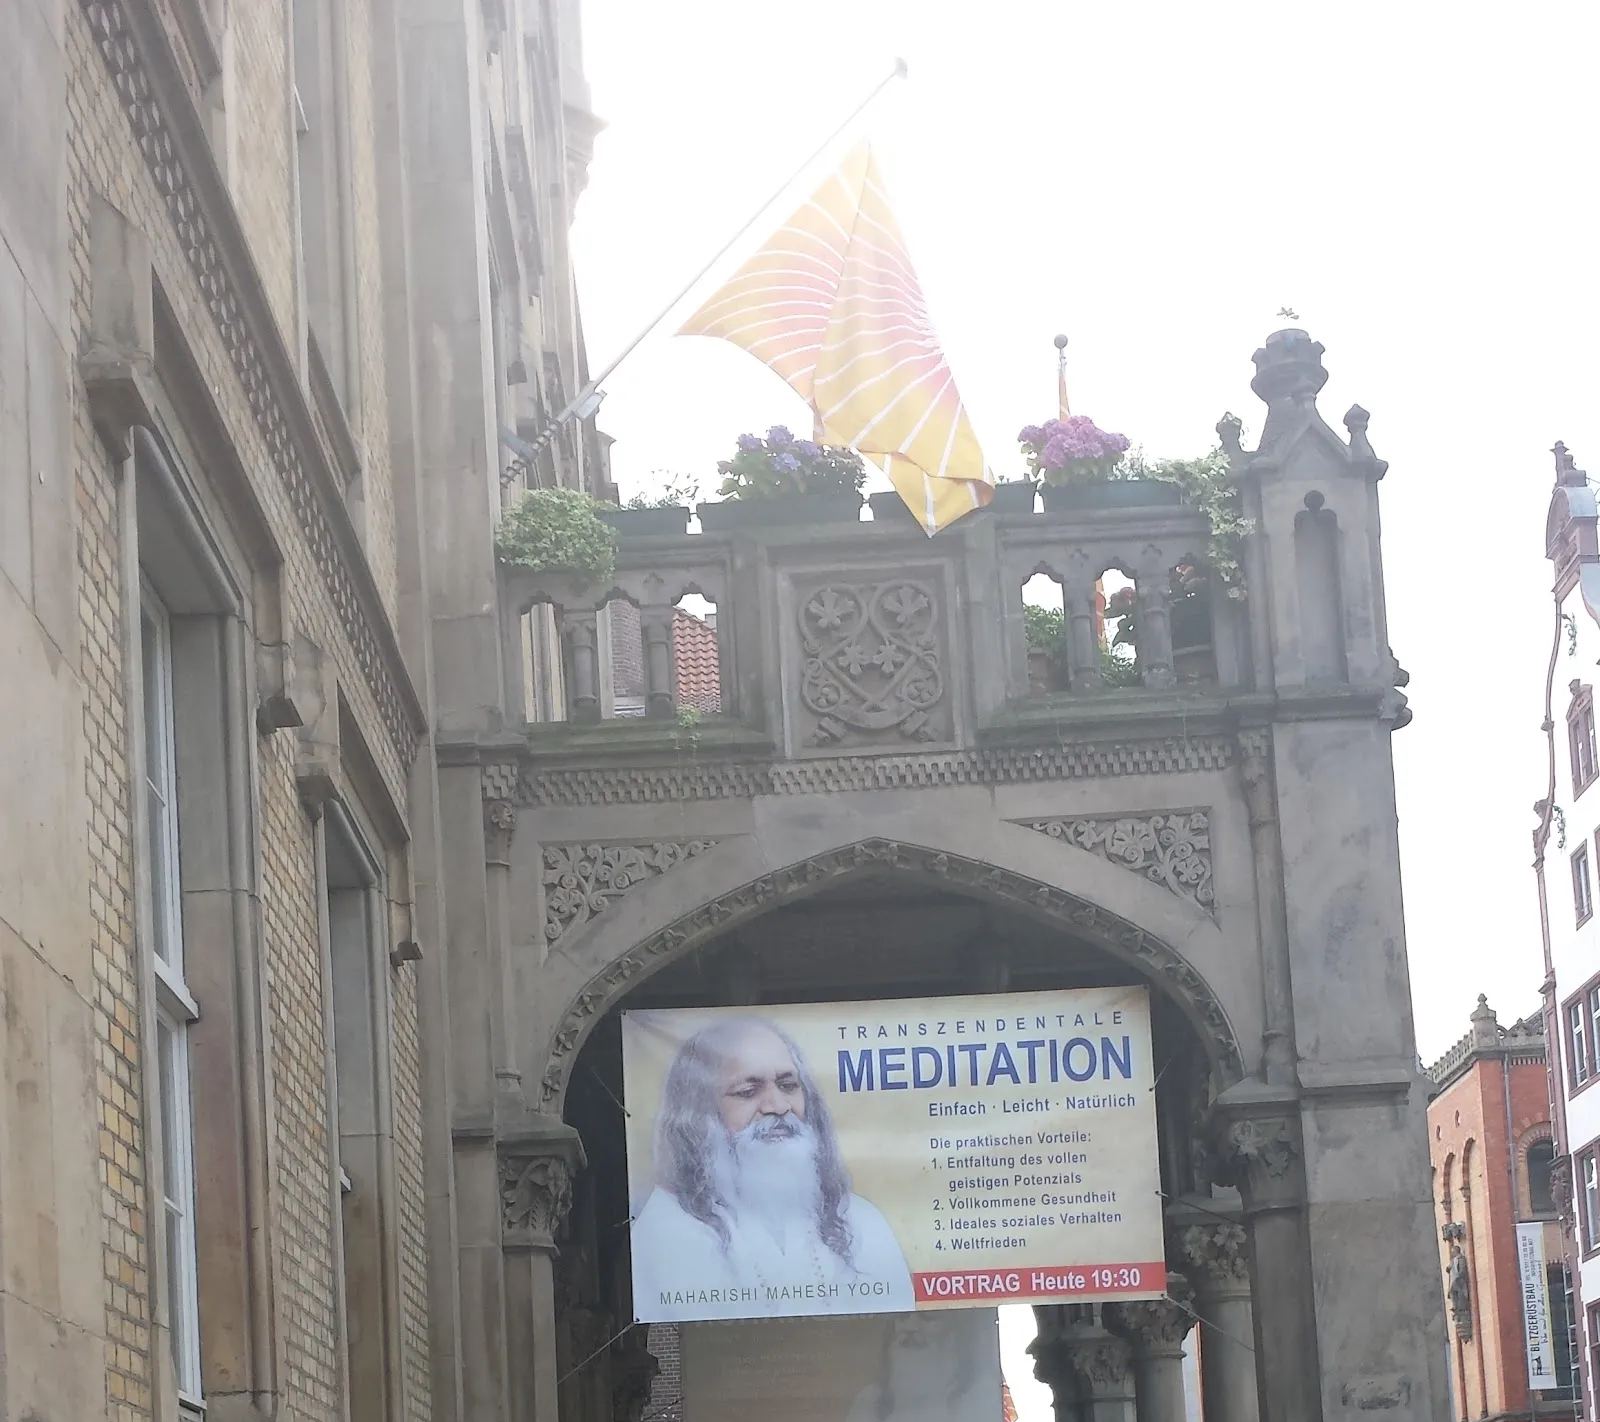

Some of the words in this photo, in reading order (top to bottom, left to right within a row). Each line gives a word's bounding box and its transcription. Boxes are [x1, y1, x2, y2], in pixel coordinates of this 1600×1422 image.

[837, 1010, 1123, 1040] TRANSZENDENTALE
[837, 1035, 1132, 1093] MEDITATION
[929, 1101, 986, 1117] Einfach
[1003, 1098, 1050, 1113] Leicht
[1066, 1093, 1136, 1110] Natürlich
[930, 1138, 951, 1149] Die
[956, 1134, 1033, 1151] praktischen
[1037, 1131, 1092, 1144] Vorteile:
[931, 1157, 943, 1170] 1.
[947, 1154, 1015, 1169] Entfaltung
[1020, 1154, 1043, 1166] des
[1047, 1152, 1087, 1165] vollen
[949, 1176, 1009, 1192] geistigen
[1014, 1172, 1082, 1187] Potenzials
[933, 1199, 944, 1211] 2.
[948, 1196, 1036, 1210] Vollkommene
[1041, 1191, 1116, 1205] Gesundheit
[934, 1219, 945, 1231] 3.
[950, 1217, 997, 1230] Ideales
[1001, 1214, 1055, 1228] soziales
[1060, 1211, 1122, 1225] Verhalten
[935, 1239, 946, 1251] 4.
[951, 1236, 1026, 1250] Weltfrieden
[922, 1273, 1020, 1296] VORTRAG
[1031, 1271, 1086, 1291] Heute
[1091, 1268, 1141, 1288] 19:30
[660, 1287, 758, 1305] MAHARISHI
[766, 1284, 839, 1300] MAHESH
[847, 1281, 891, 1297] YOGI
